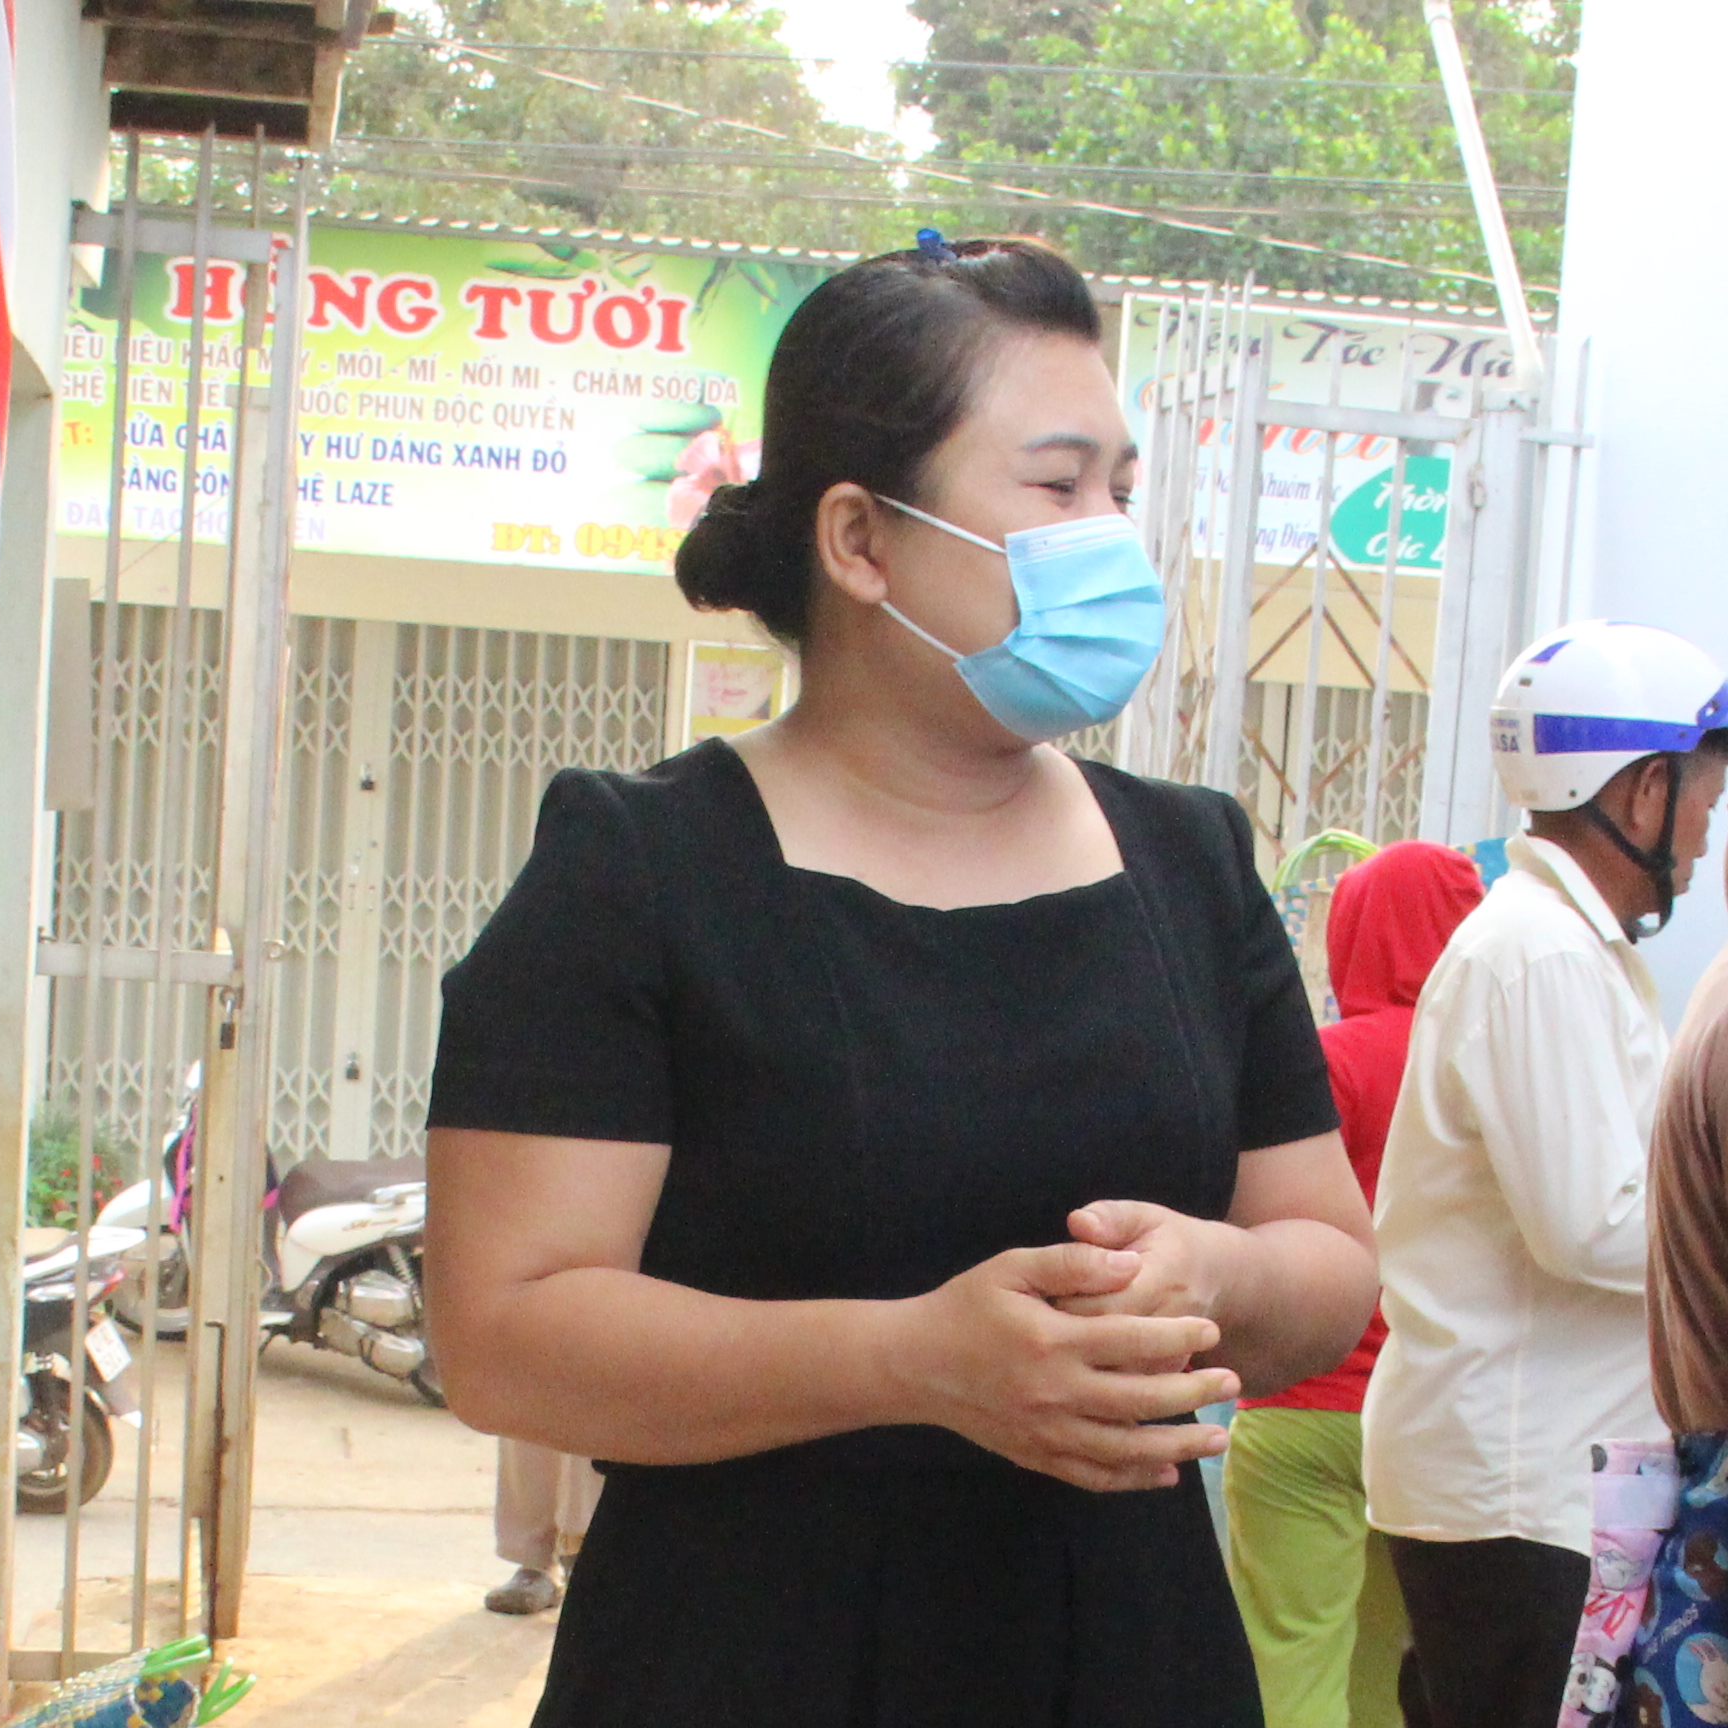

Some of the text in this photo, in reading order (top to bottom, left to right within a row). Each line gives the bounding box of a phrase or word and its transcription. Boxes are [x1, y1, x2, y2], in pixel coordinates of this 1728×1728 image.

[169, 236, 687, 353] HNG TƯƠI
[336, 346, 383, 380] MÔI
[461, 353, 502, 387] NỐI
[512, 365, 541, 390] MI
[572, 366, 643, 398] CHĂM
[358, 394, 424, 423] PHUN
[434, 393, 484, 429] ĐỘC
[493, 398, 575, 432] QUYỀN
[372, 432, 442, 466] DÁNG
[452, 444, 522, 472] XANH
[531, 441, 568, 474] ĐỎ
[336, 479, 395, 507] LAZE
